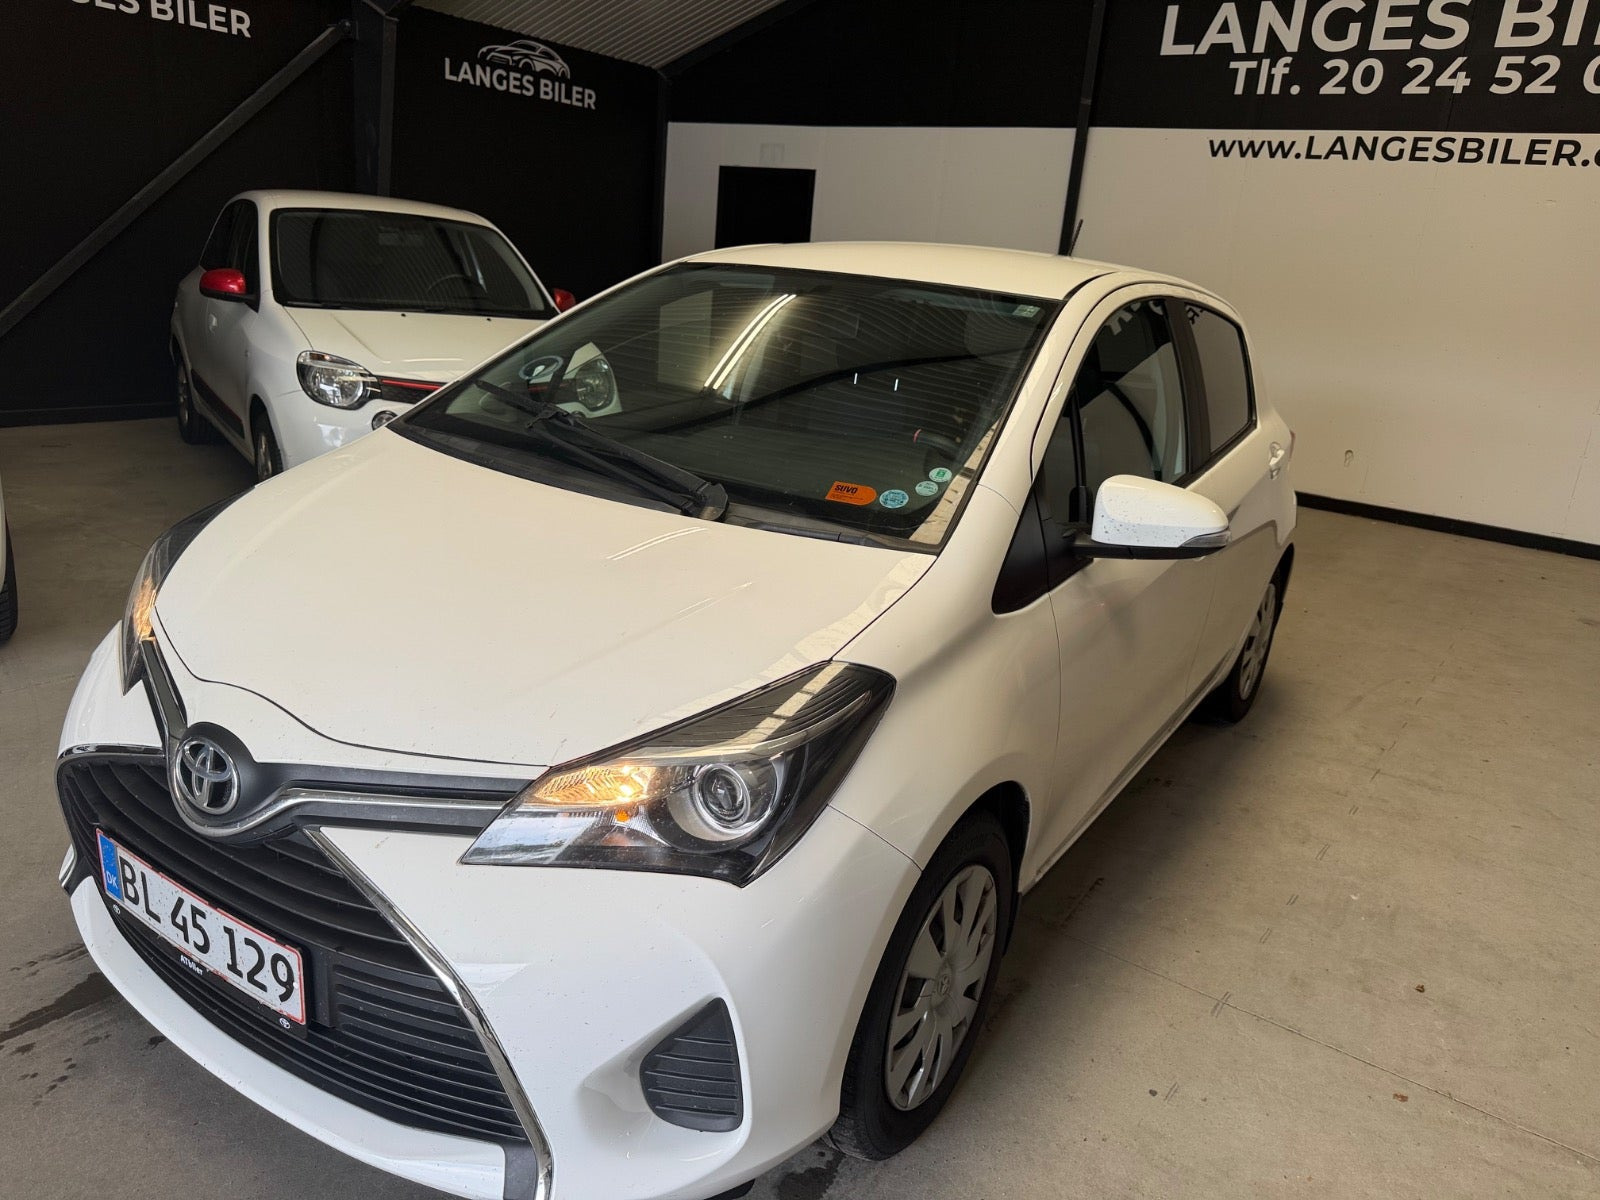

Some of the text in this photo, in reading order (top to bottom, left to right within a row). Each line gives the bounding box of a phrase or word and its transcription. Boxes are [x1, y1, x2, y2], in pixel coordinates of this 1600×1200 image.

[150, 0, 252, 38] BILER
[1159, 0, 1600, 56] LANGES BI
[444, 57, 597, 110] LANGES BILER
[1228, 56, 1301, 95] Tlf.
[1319, 57, 1384, 95] 20
[1401, 56, 1471, 95] 24
[1488, 54, 1561, 95] 52
[105, 870, 118, 889] DK
[119, 856, 296, 1003] BL 45 129
